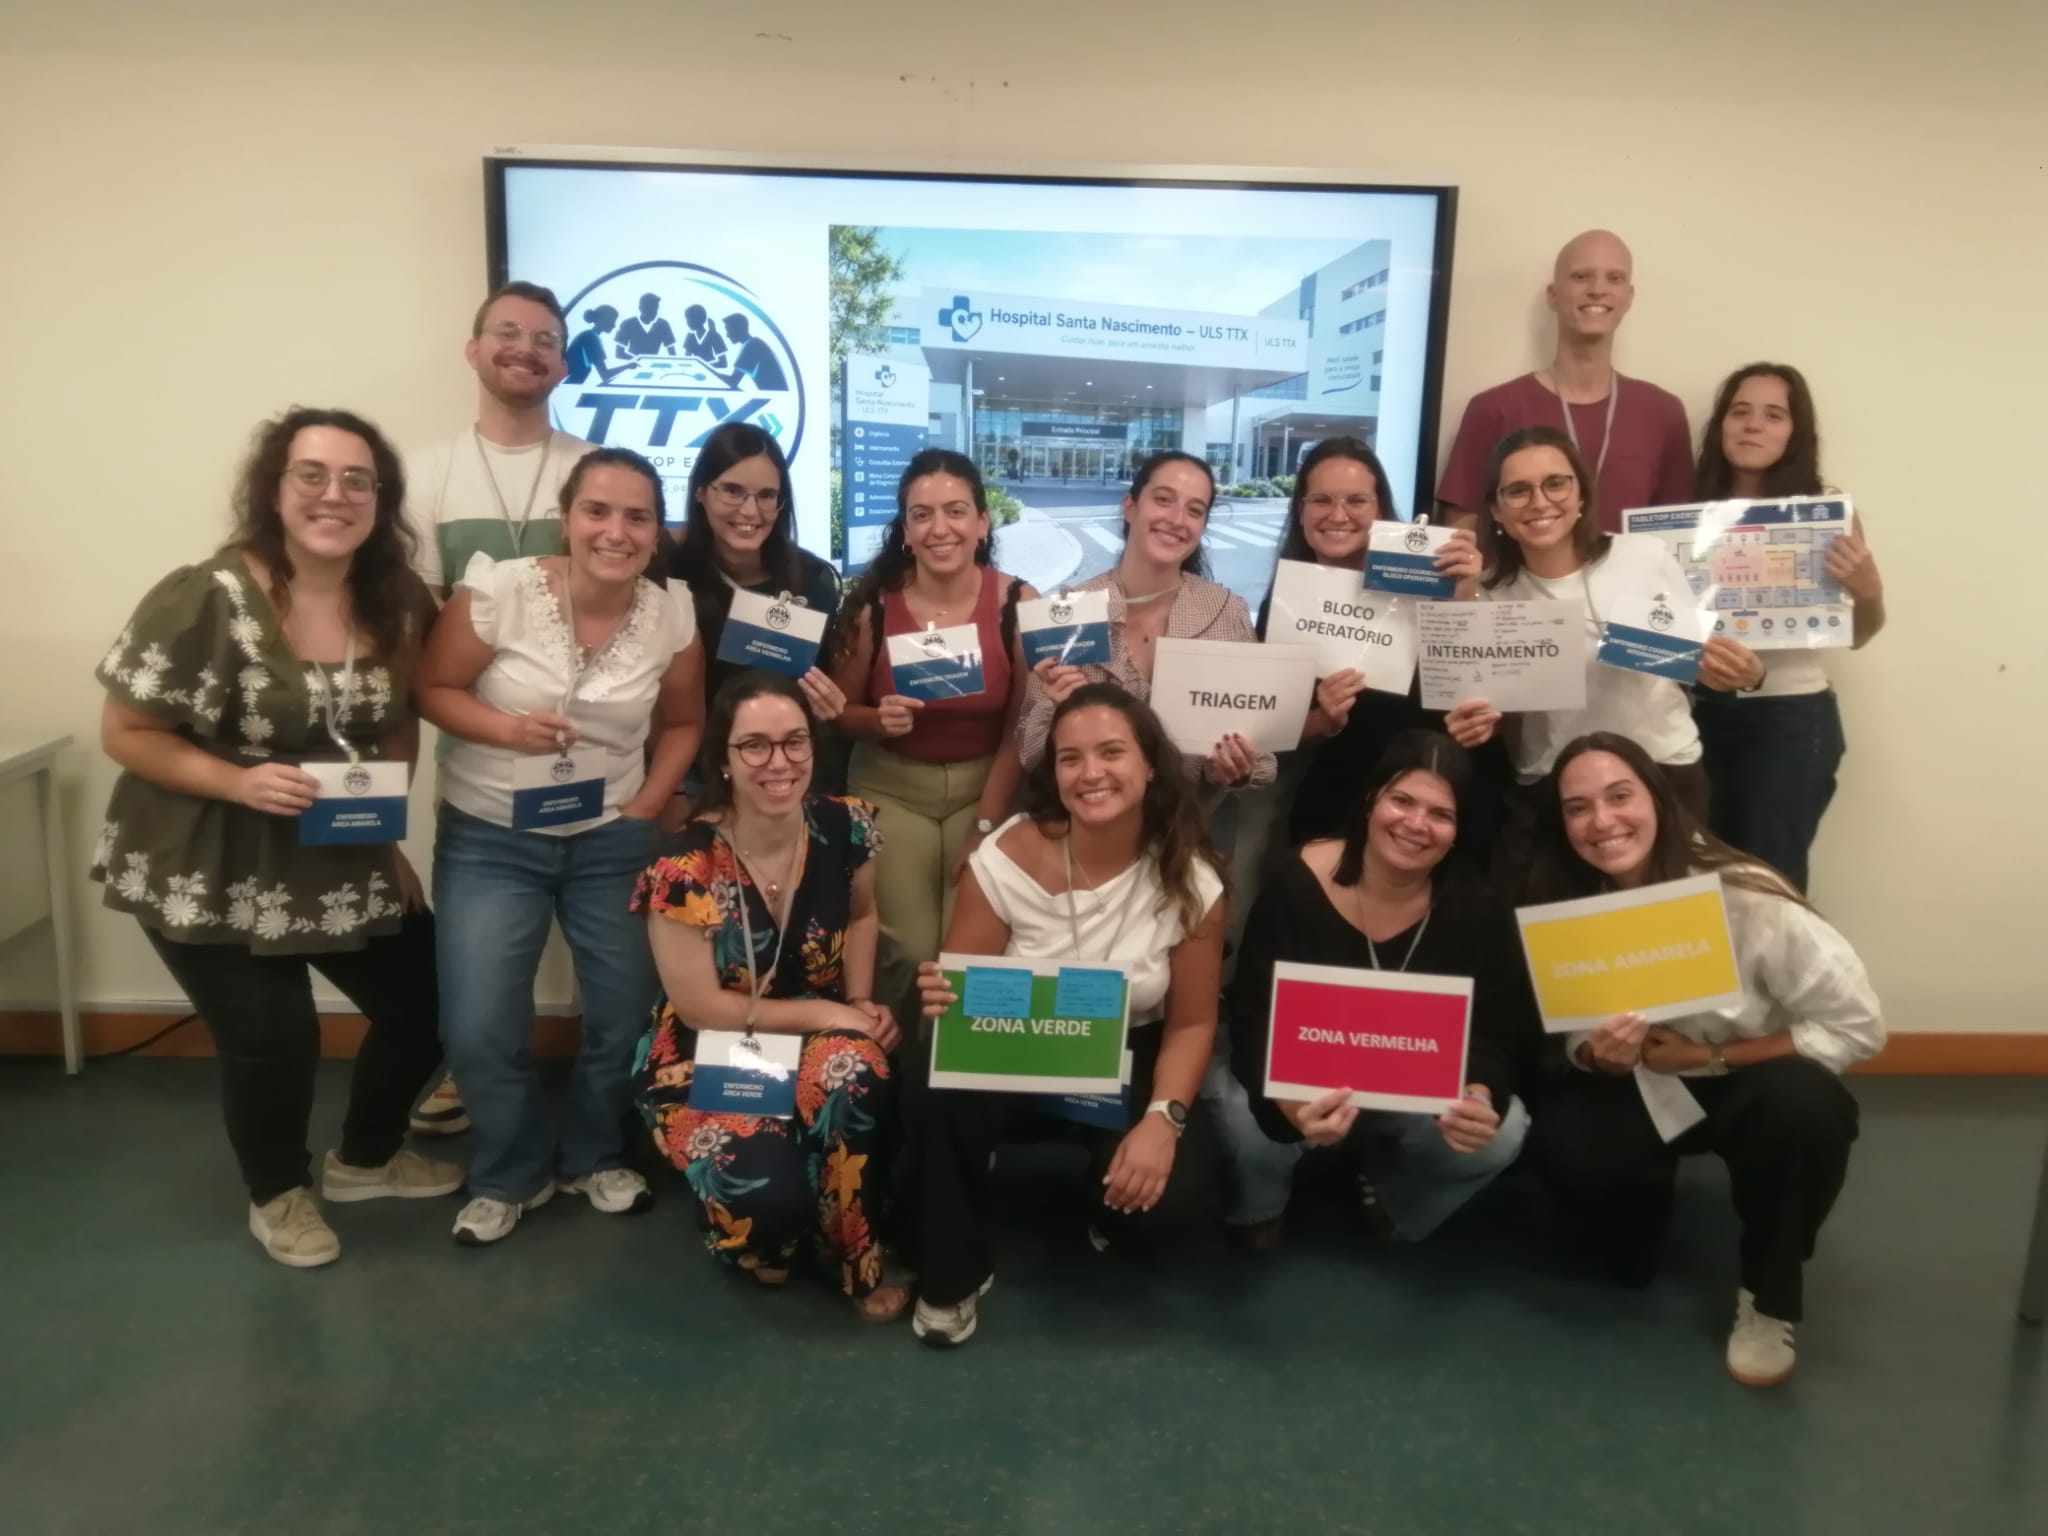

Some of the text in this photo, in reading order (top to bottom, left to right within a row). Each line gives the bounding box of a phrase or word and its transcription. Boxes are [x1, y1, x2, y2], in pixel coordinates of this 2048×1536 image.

[990, 308, 1051, 328] Hospital
[1056, 313, 1097, 330] Santa
[1101, 316, 1182, 336] Nascimento
[1199, 325, 1223, 339] ULS
[1226, 327, 1249, 341] TTX
[1265, 337, 1297, 348] ULS TTX
[575, 392, 772, 448] TTX
[1323, 600, 1375, 621] BLOCO
[1295, 618, 1394, 647] OPERATÓRIO
[1427, 643, 1560, 660] INTERNAMENTO
[1189, 690, 1277, 710] TRIAGEM
[1552, 938, 1712, 979] ZONA AMARELA
[970, 1016, 1092, 1036] ZONA VERDE
[1298, 1026, 1439, 1053] ZONA VERMELHA
